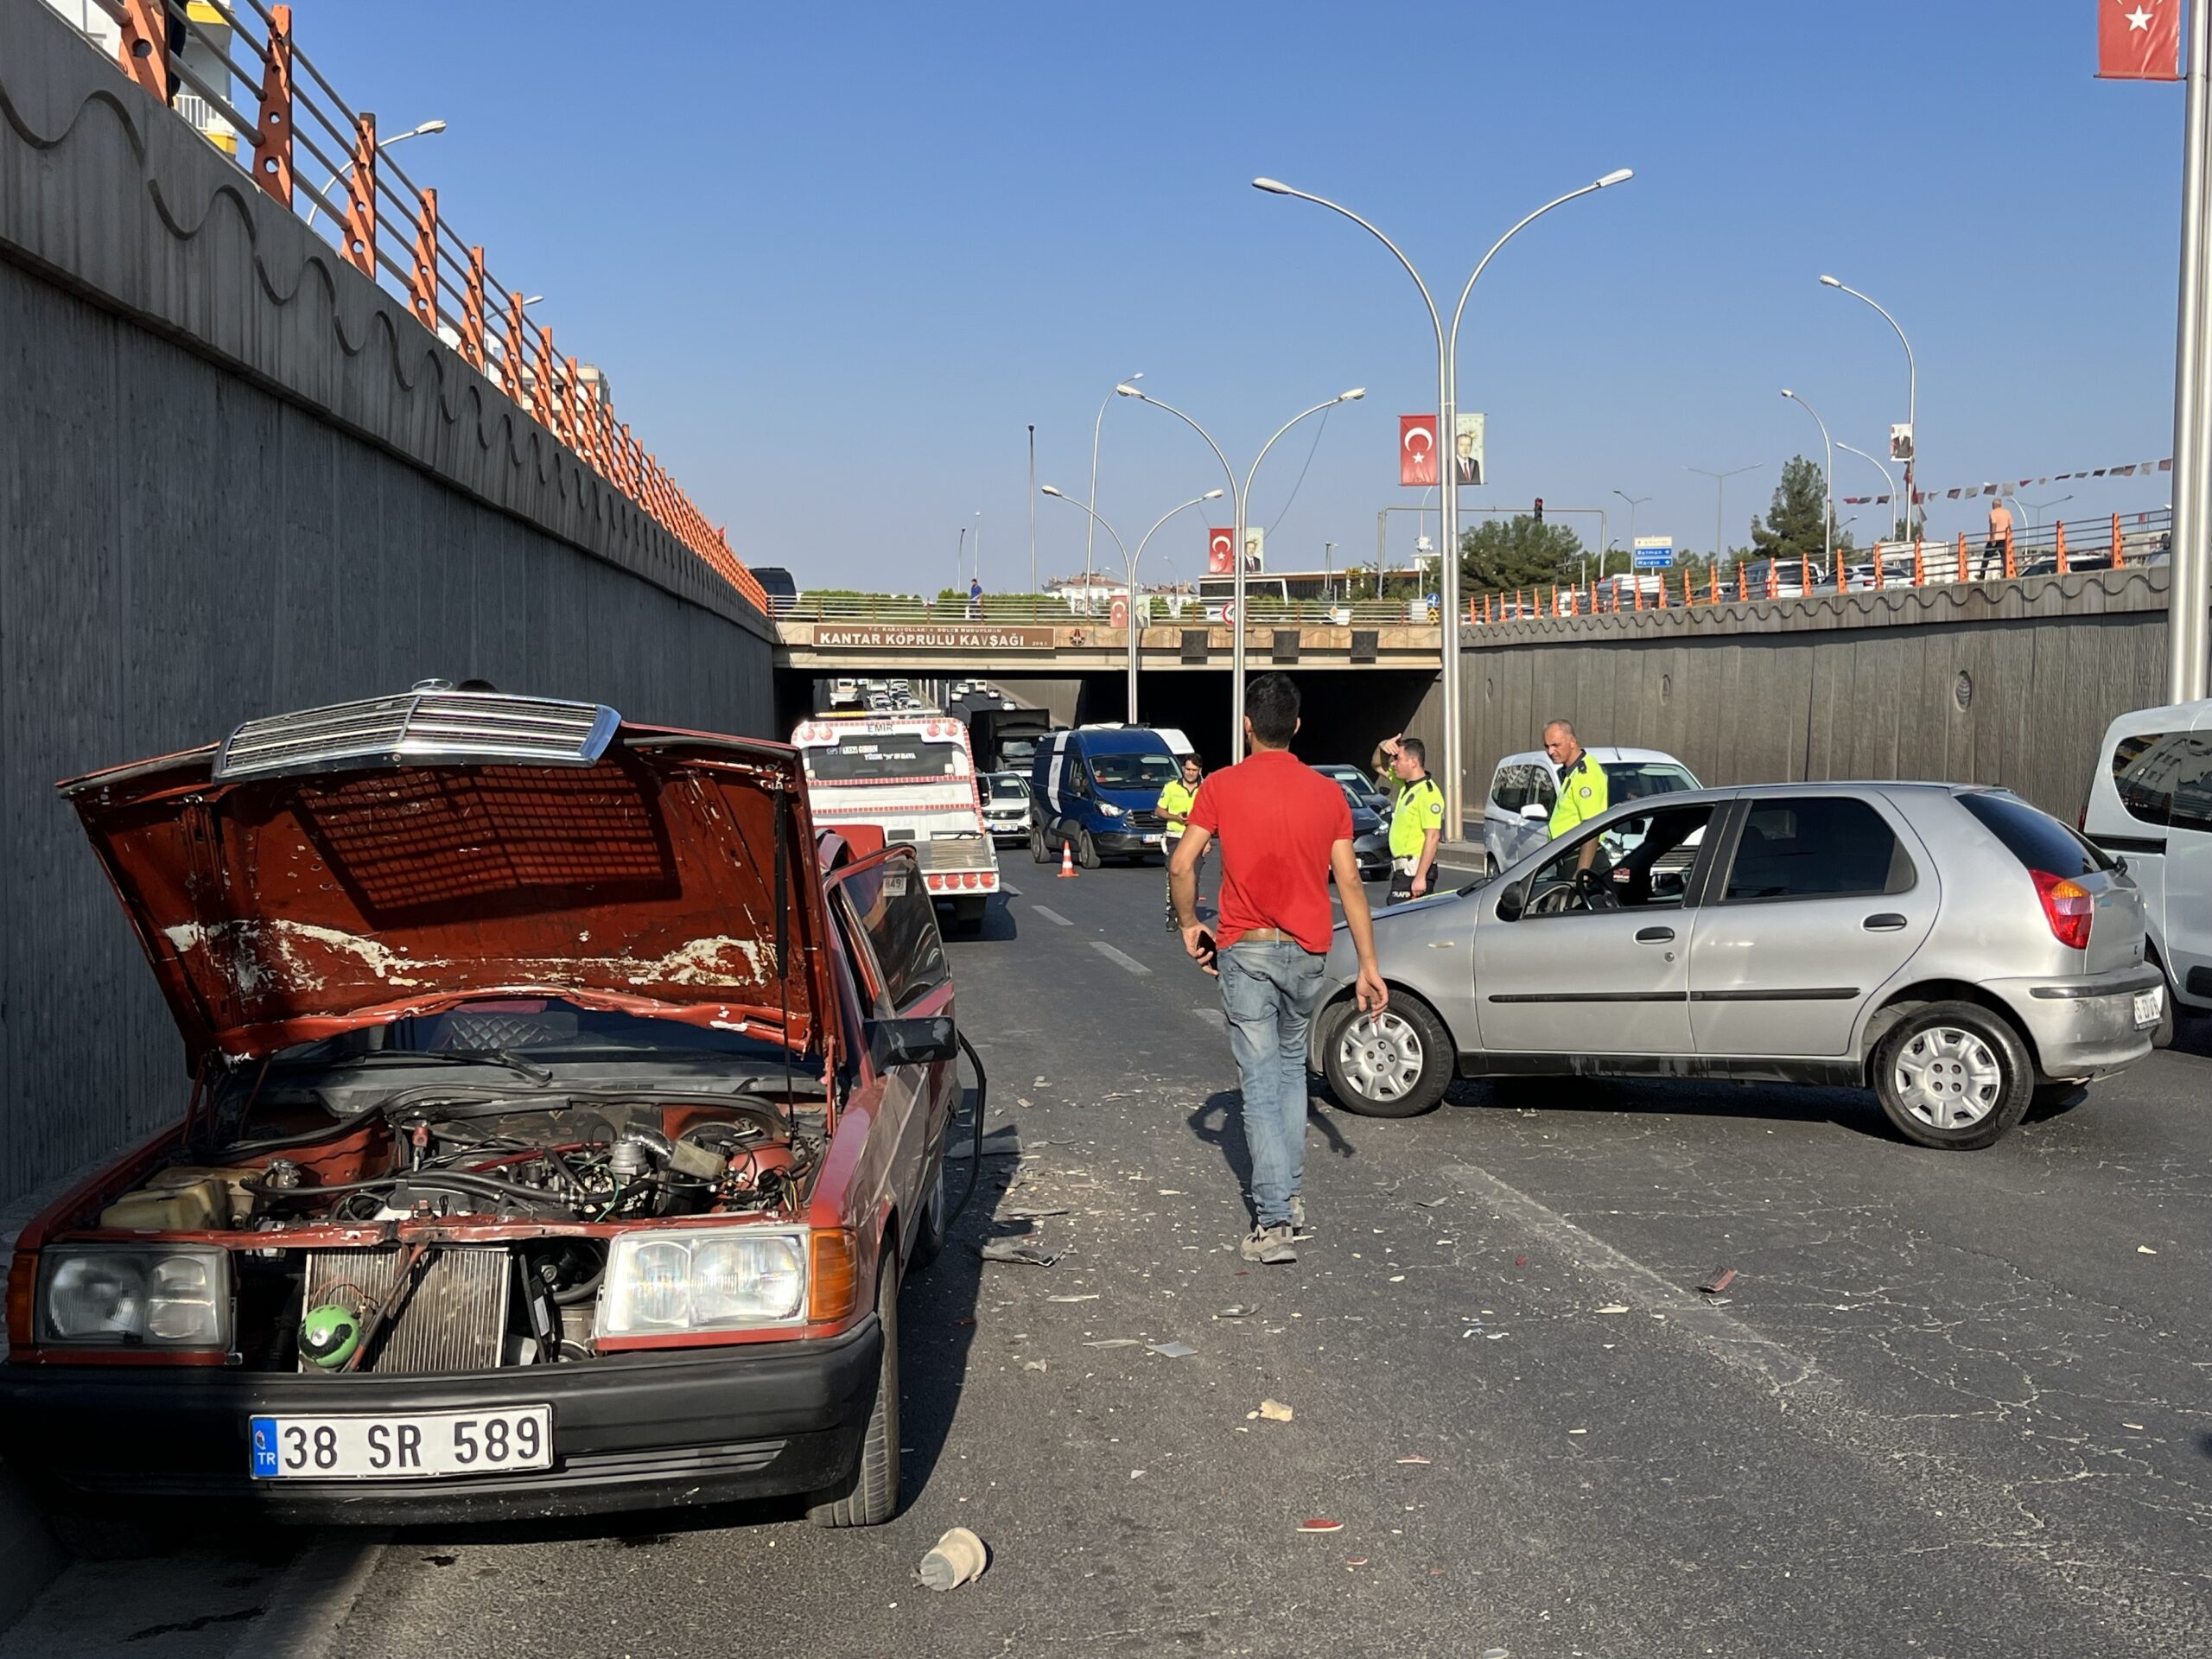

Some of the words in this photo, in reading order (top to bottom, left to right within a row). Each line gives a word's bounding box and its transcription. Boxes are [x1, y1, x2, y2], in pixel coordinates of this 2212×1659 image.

[820, 632, 881, 645] KANTAR
[959, 632, 1024, 647] KAVŞAĞI
[257, 1452, 276, 1465] TR
[283, 1427, 338, 1469] 38
[367, 1425, 422, 1469] SR
[454, 1417, 540, 1464] 589
